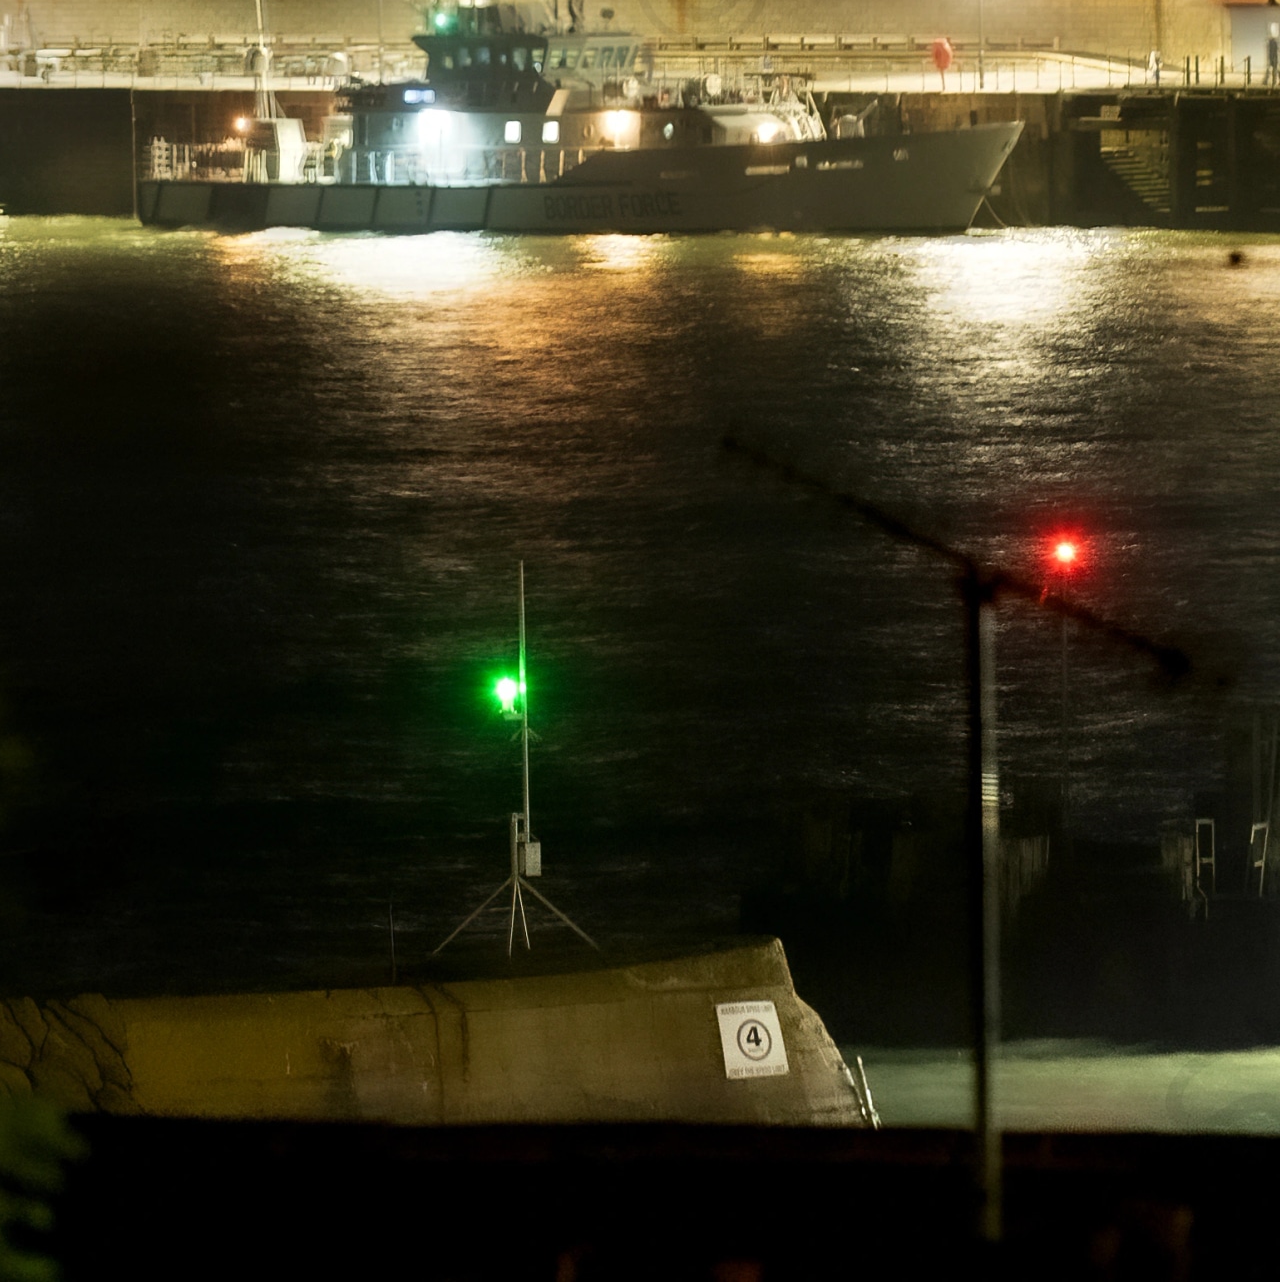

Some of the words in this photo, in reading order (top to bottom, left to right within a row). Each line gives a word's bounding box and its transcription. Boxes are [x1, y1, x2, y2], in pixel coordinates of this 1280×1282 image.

[543, 194, 613, 220] BORDER
[617, 190, 682, 218] FORCE
[746, 1025, 762, 1047] 4
